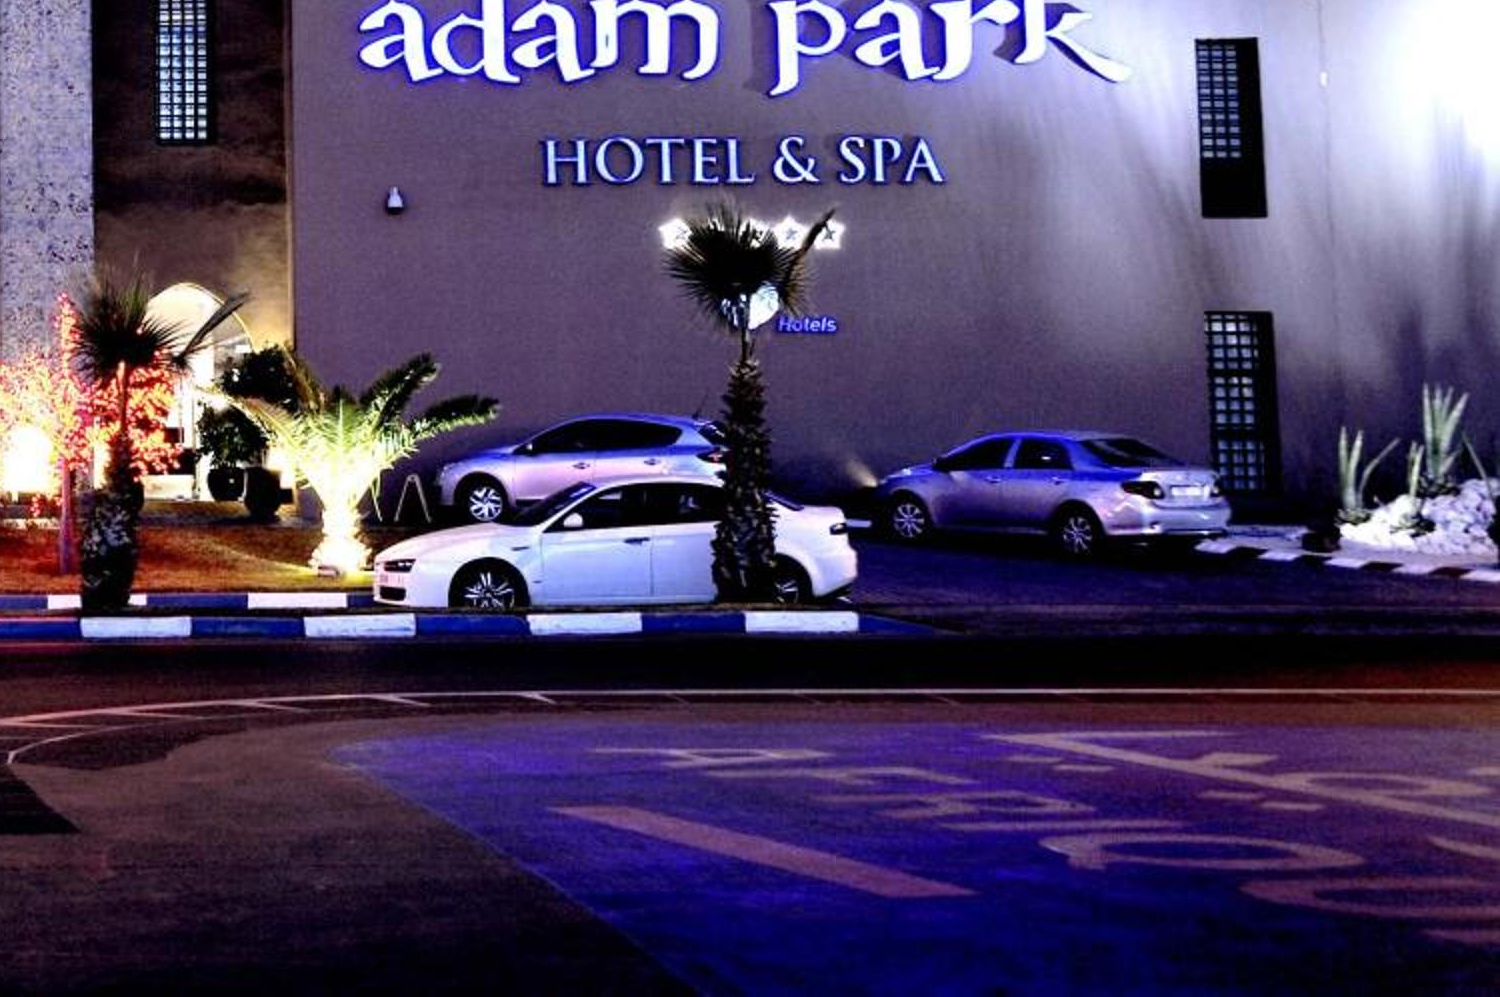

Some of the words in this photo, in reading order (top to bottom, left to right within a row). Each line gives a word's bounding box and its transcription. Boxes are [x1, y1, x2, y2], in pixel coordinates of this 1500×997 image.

[542, 135, 756, 185] HOTEL
[772, 135, 821, 185] &
[838, 135, 946, 185] SPA
[778, 316, 837, 332] Hotels
